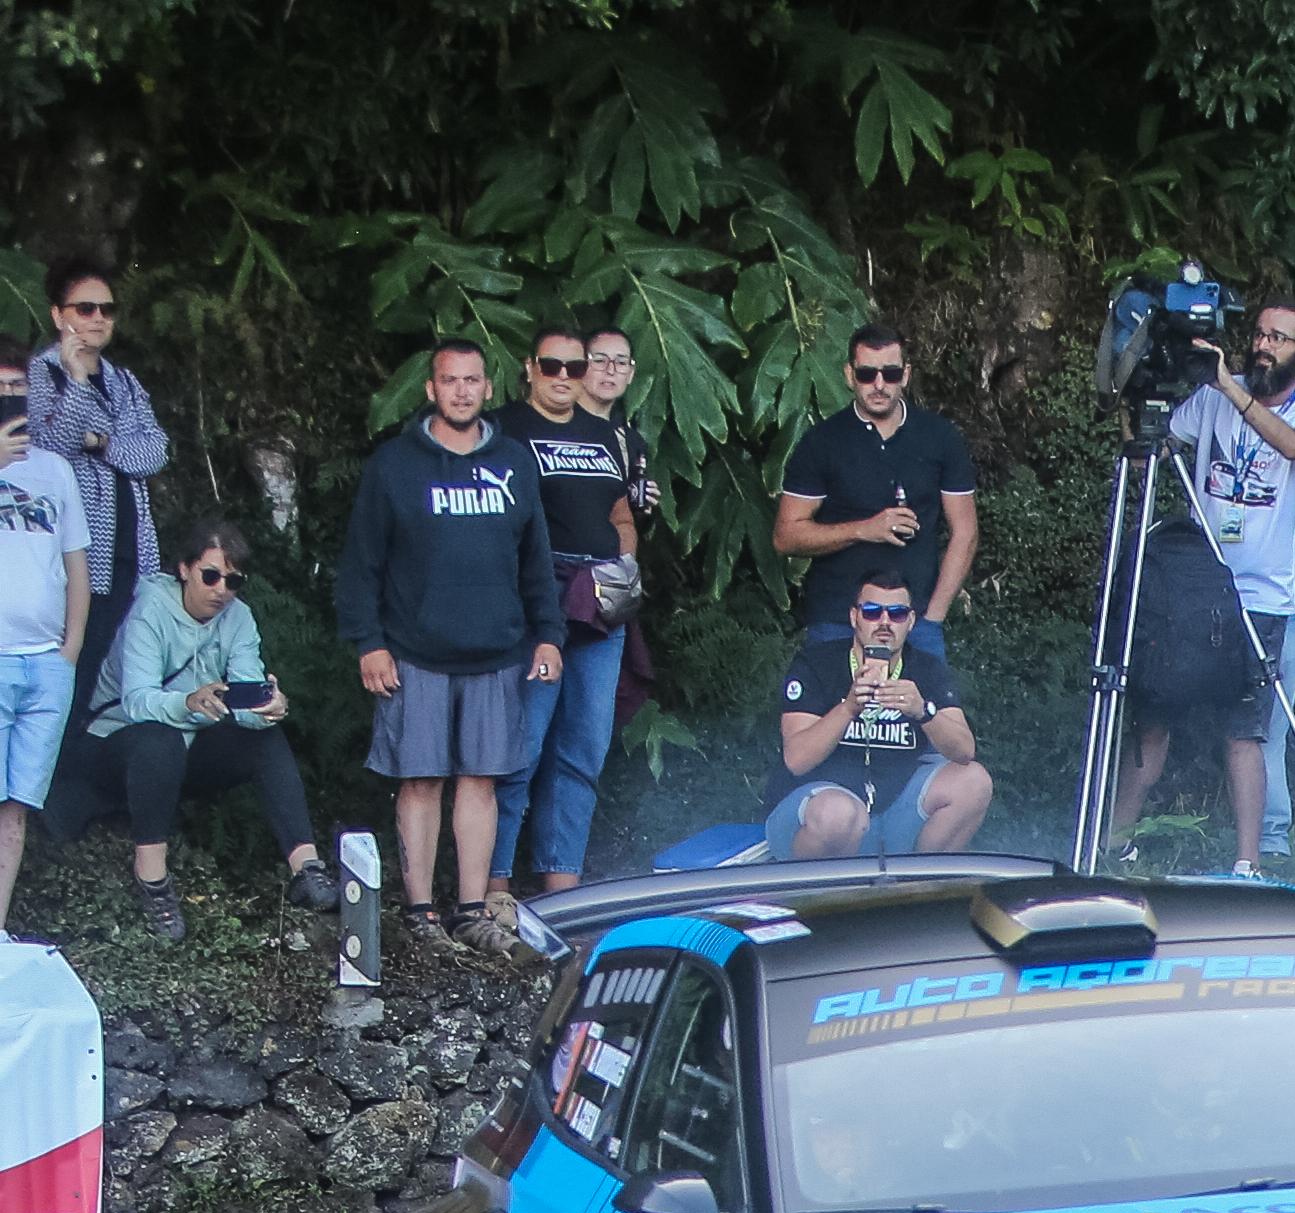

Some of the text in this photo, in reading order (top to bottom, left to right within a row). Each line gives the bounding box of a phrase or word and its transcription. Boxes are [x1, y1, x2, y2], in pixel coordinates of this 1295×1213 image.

[547, 443, 598, 457] Team
[541, 452, 619, 475] VALVOLINE
[431, 487, 505, 515] PUMA
[844, 720, 911, 746] ALVOLINE
[812, 971, 1005, 1025] Auto
